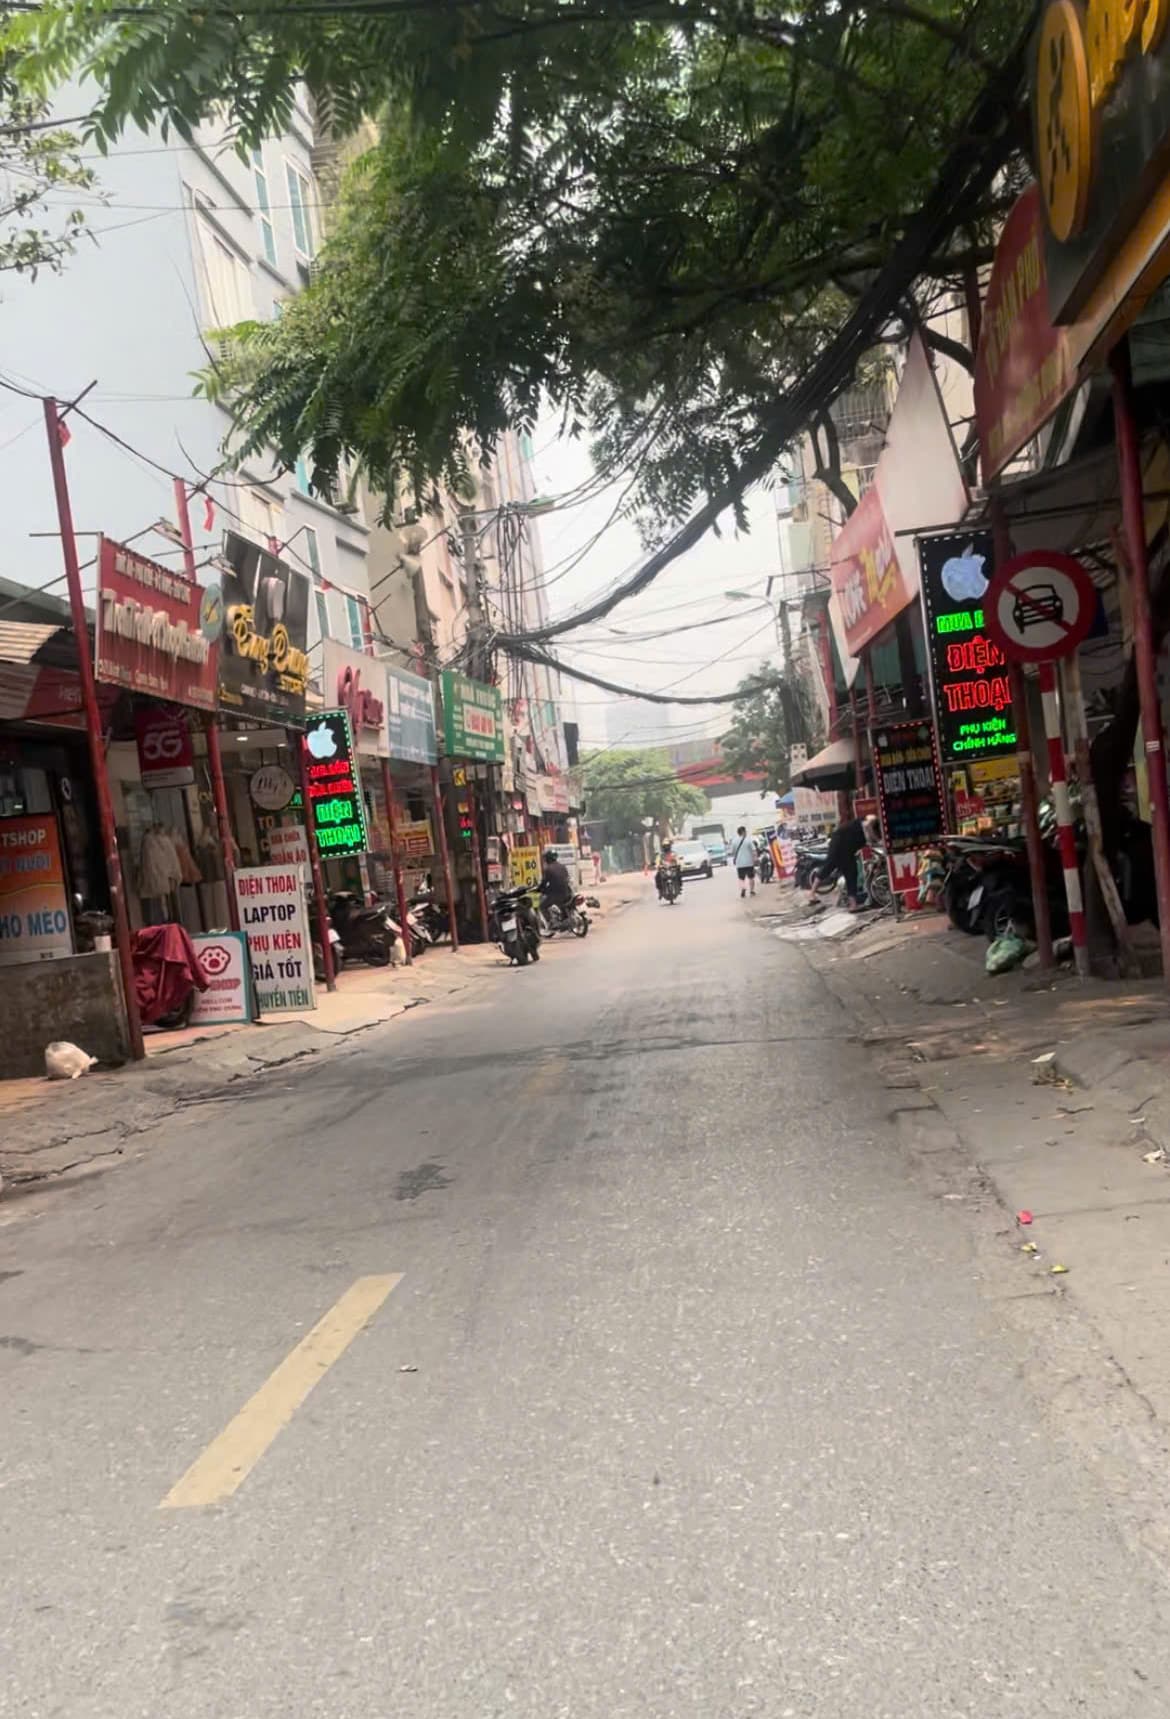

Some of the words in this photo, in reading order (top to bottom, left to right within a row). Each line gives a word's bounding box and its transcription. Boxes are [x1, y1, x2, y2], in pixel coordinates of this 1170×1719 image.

[936, 612, 974, 634] MUA
[943, 676, 1013, 712] THOẠI
[143, 728, 184, 761] 5G
[265, 874, 297, 896] THOẠI
[243, 904, 297, 924] LAPTOP
[272, 929, 302, 954] KIỆN
[277, 954, 303, 978] TỐT
